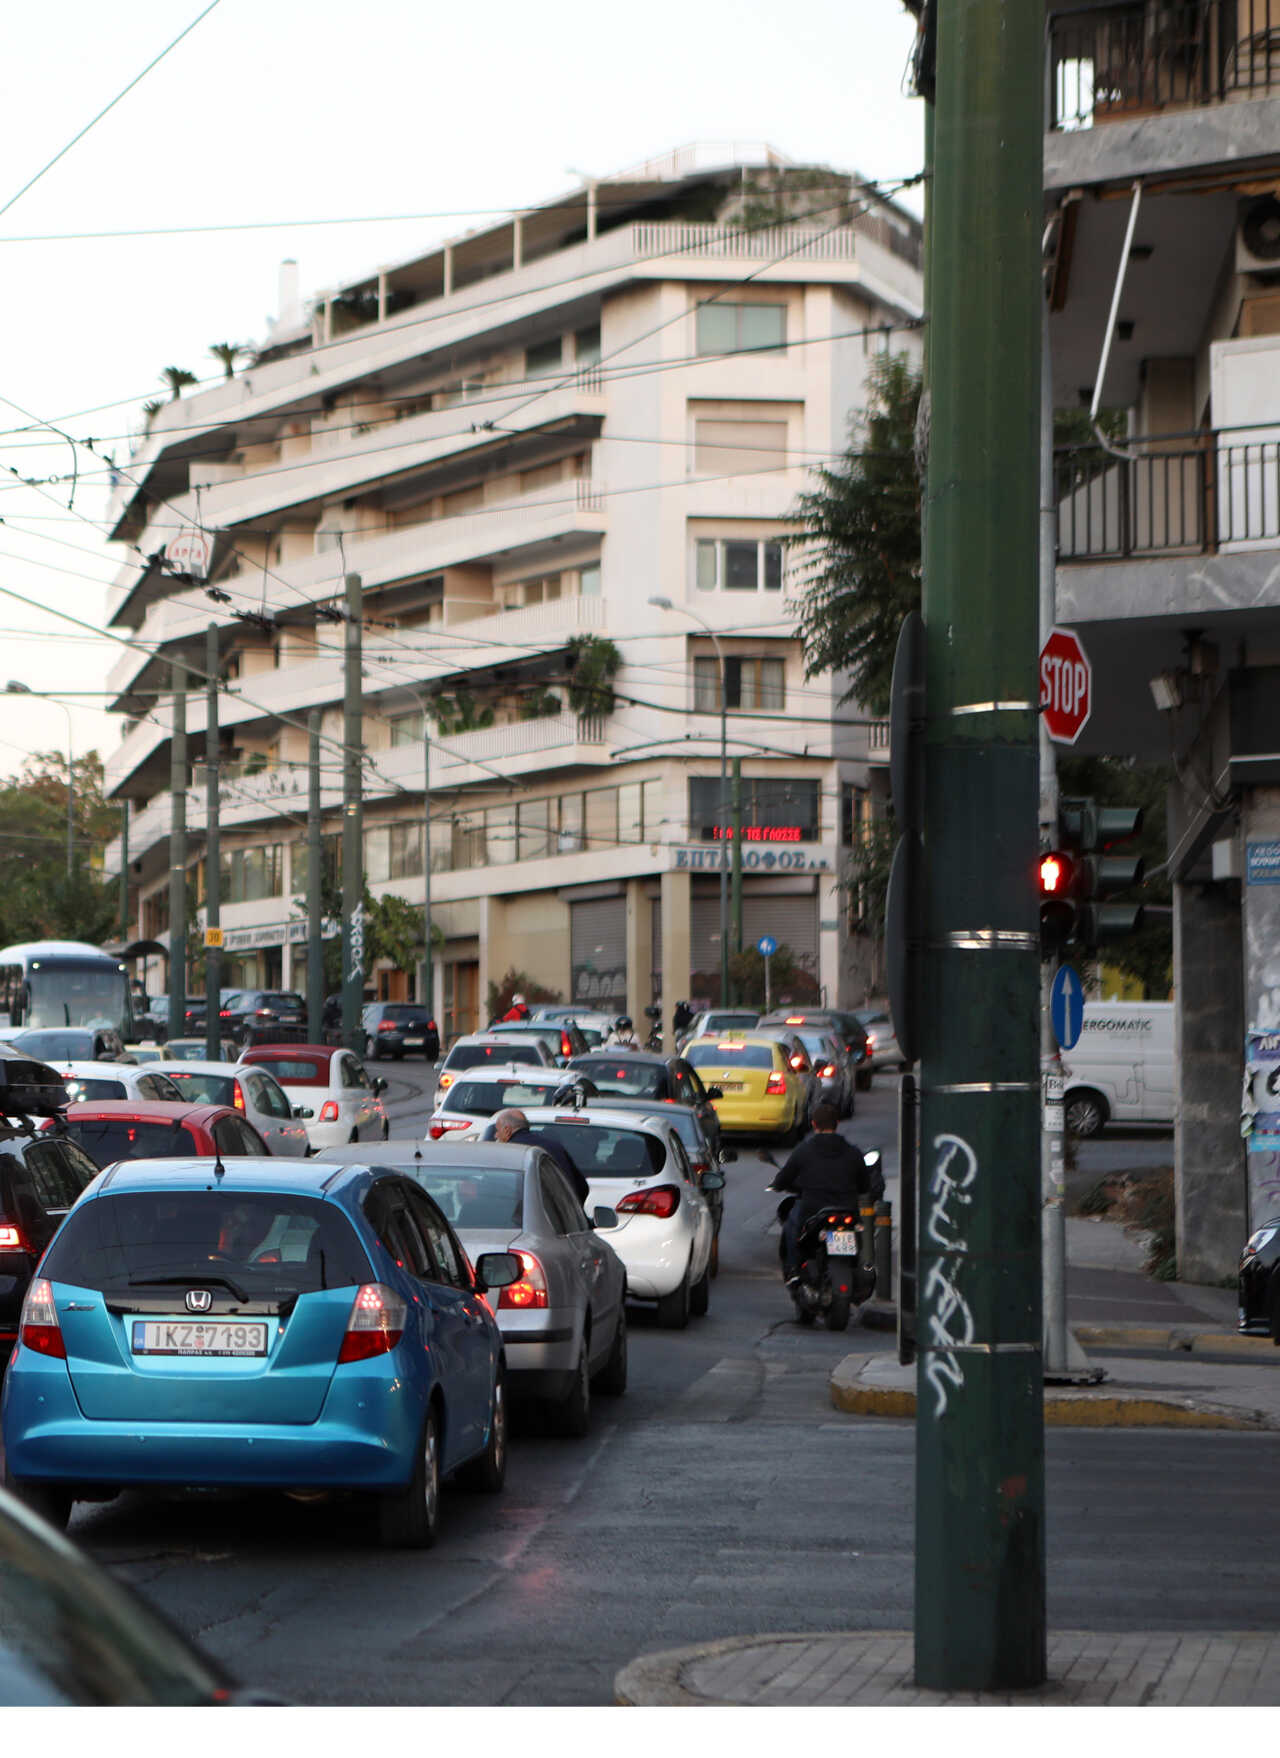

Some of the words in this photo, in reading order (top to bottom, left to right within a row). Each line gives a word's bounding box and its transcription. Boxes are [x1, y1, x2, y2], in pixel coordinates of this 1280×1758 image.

[1040, 655, 1086, 717] STOP
[676, 850, 806, 869] ΕΠΤΟΦΟΣ
[1082, 1018, 1154, 1032] ERGOMATIC
